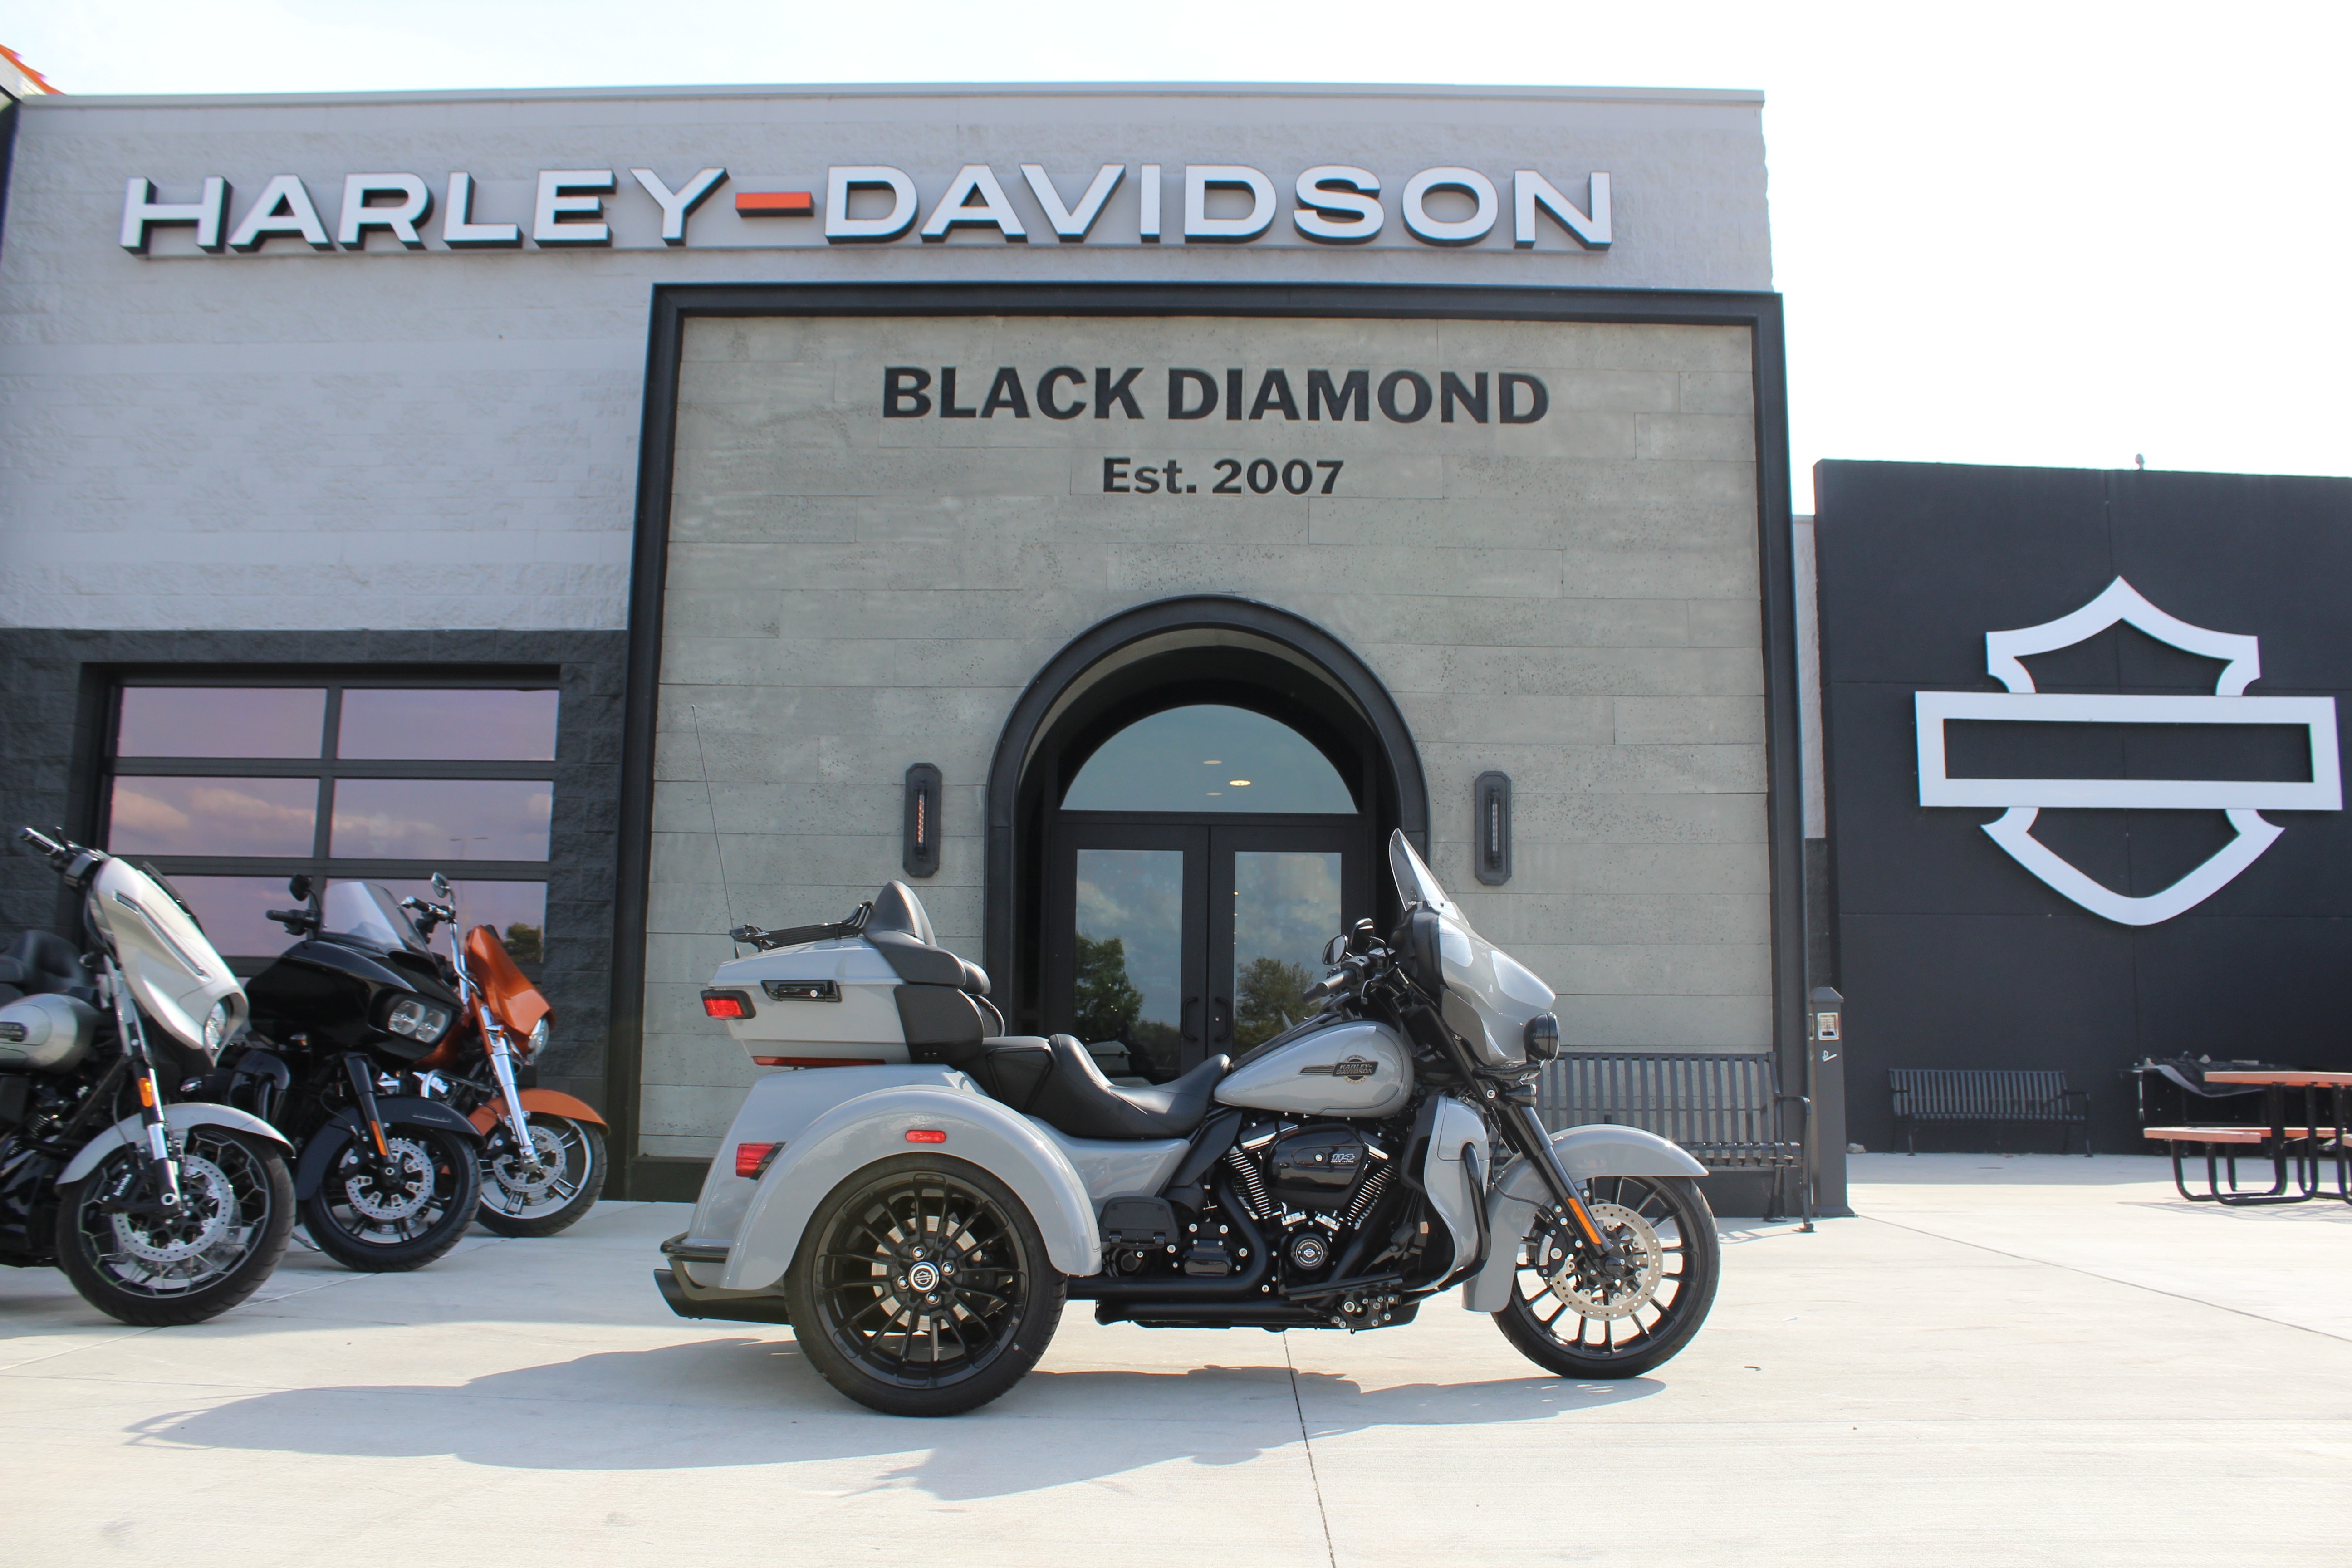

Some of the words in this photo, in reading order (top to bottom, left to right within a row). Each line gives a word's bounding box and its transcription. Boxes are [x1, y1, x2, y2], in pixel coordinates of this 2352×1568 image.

[119, 164, 1613, 255] HARLEY-DAVIDSON
[882, 366, 1145, 420] BLACK
[1167, 368, 1548, 425] DIAMOND
[1102, 457, 1197, 494] Est.
[1212, 458, 1344, 495] 2007
